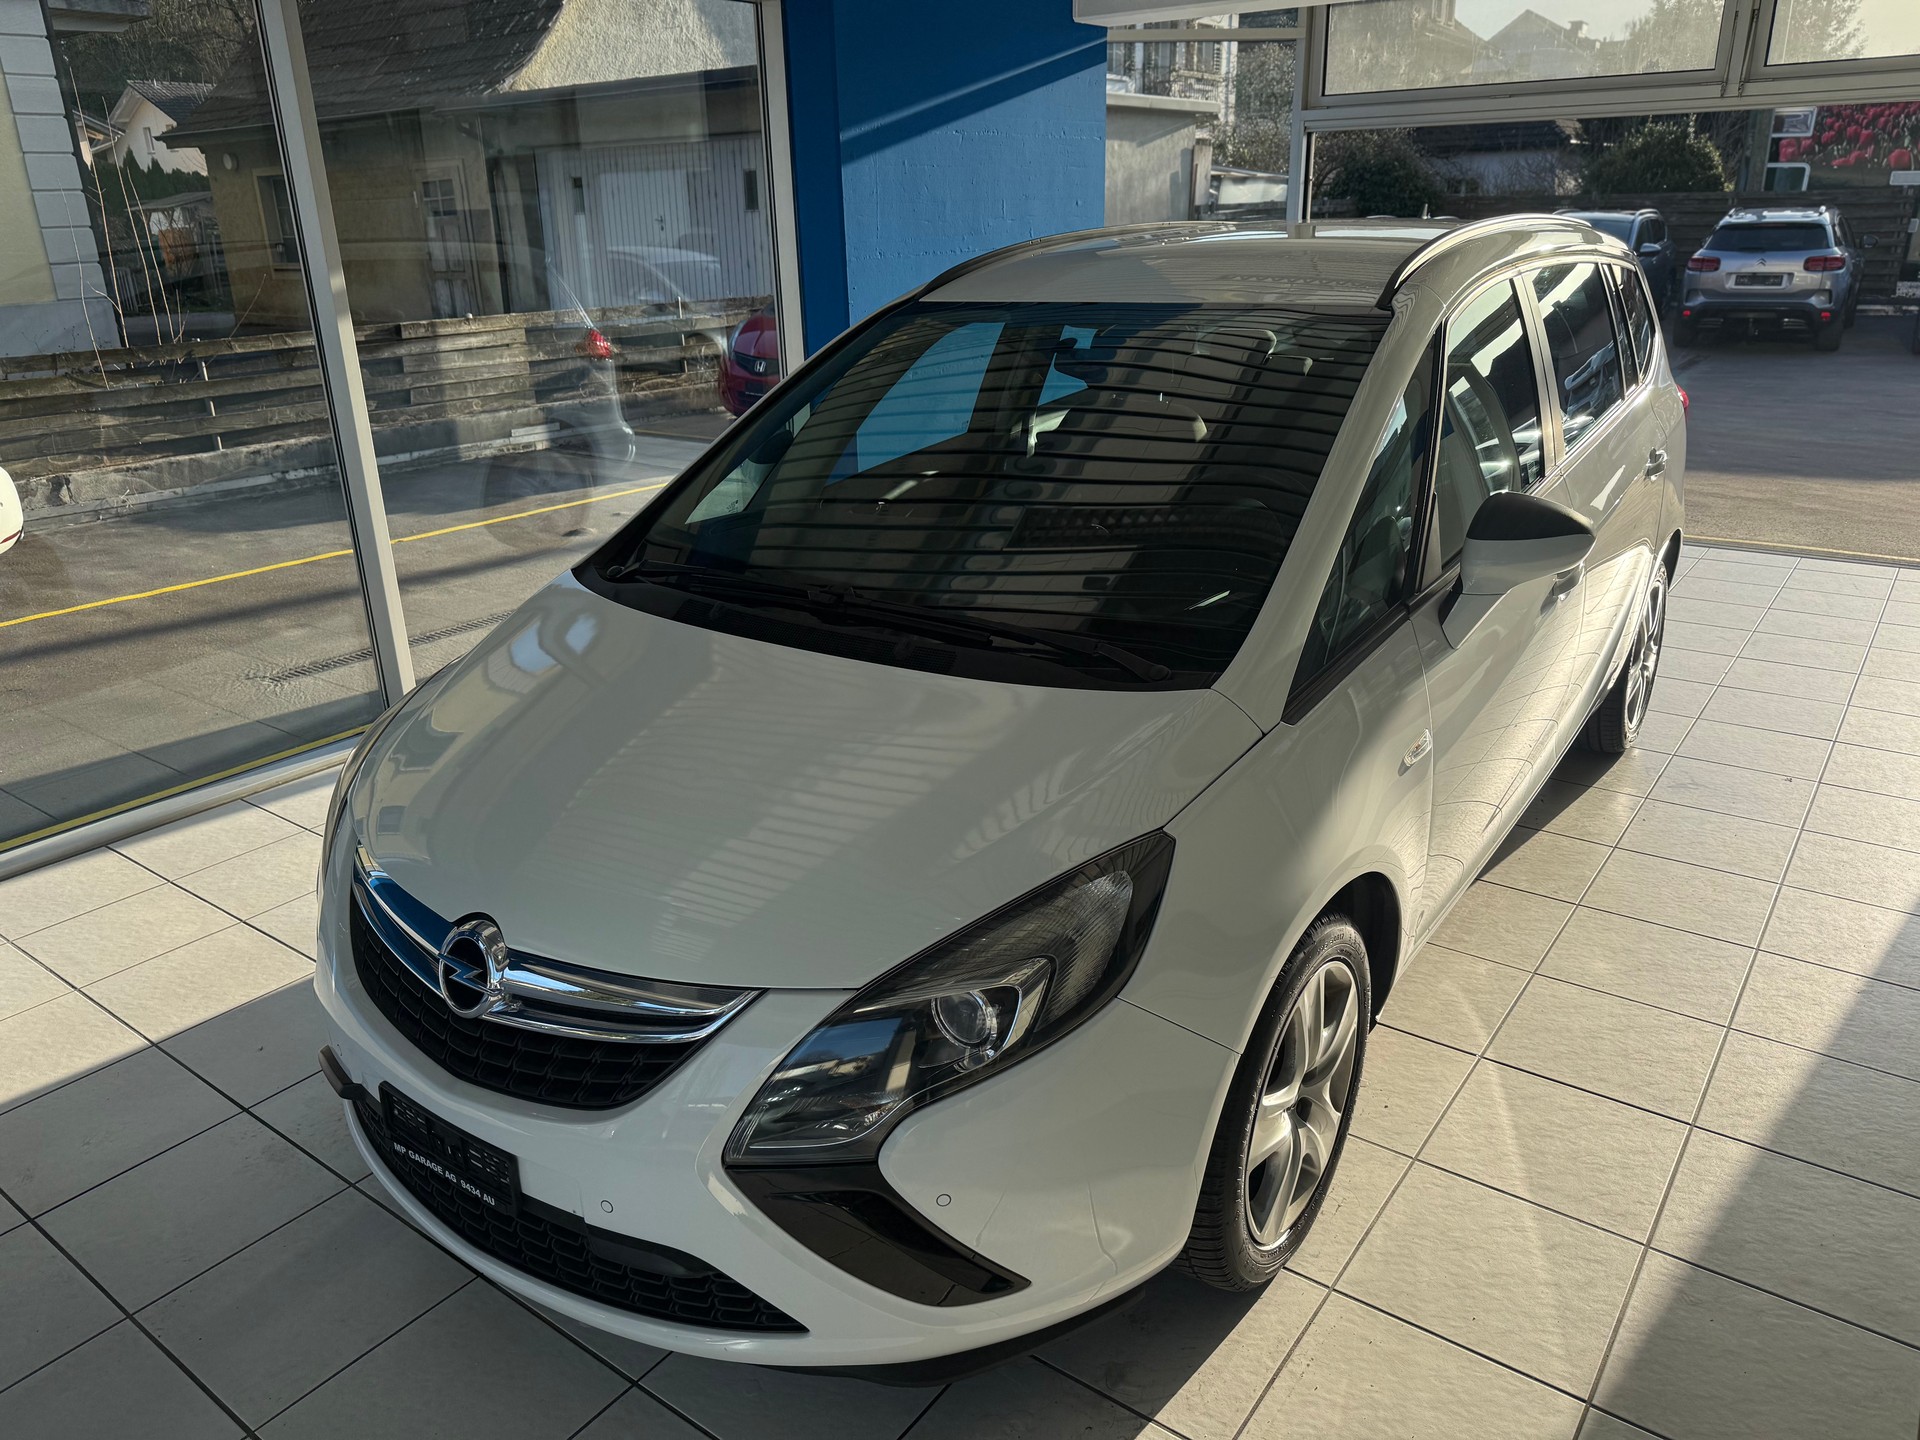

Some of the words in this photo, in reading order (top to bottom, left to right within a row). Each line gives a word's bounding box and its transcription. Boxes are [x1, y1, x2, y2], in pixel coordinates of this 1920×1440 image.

[394, 1142, 406, 1154] MP
[408, 1150, 443, 1175] GARAGE
[445, 1171, 457, 1183] AG
[460, 1180, 481, 1198] 9434
[483, 1193, 495, 1206] AU
